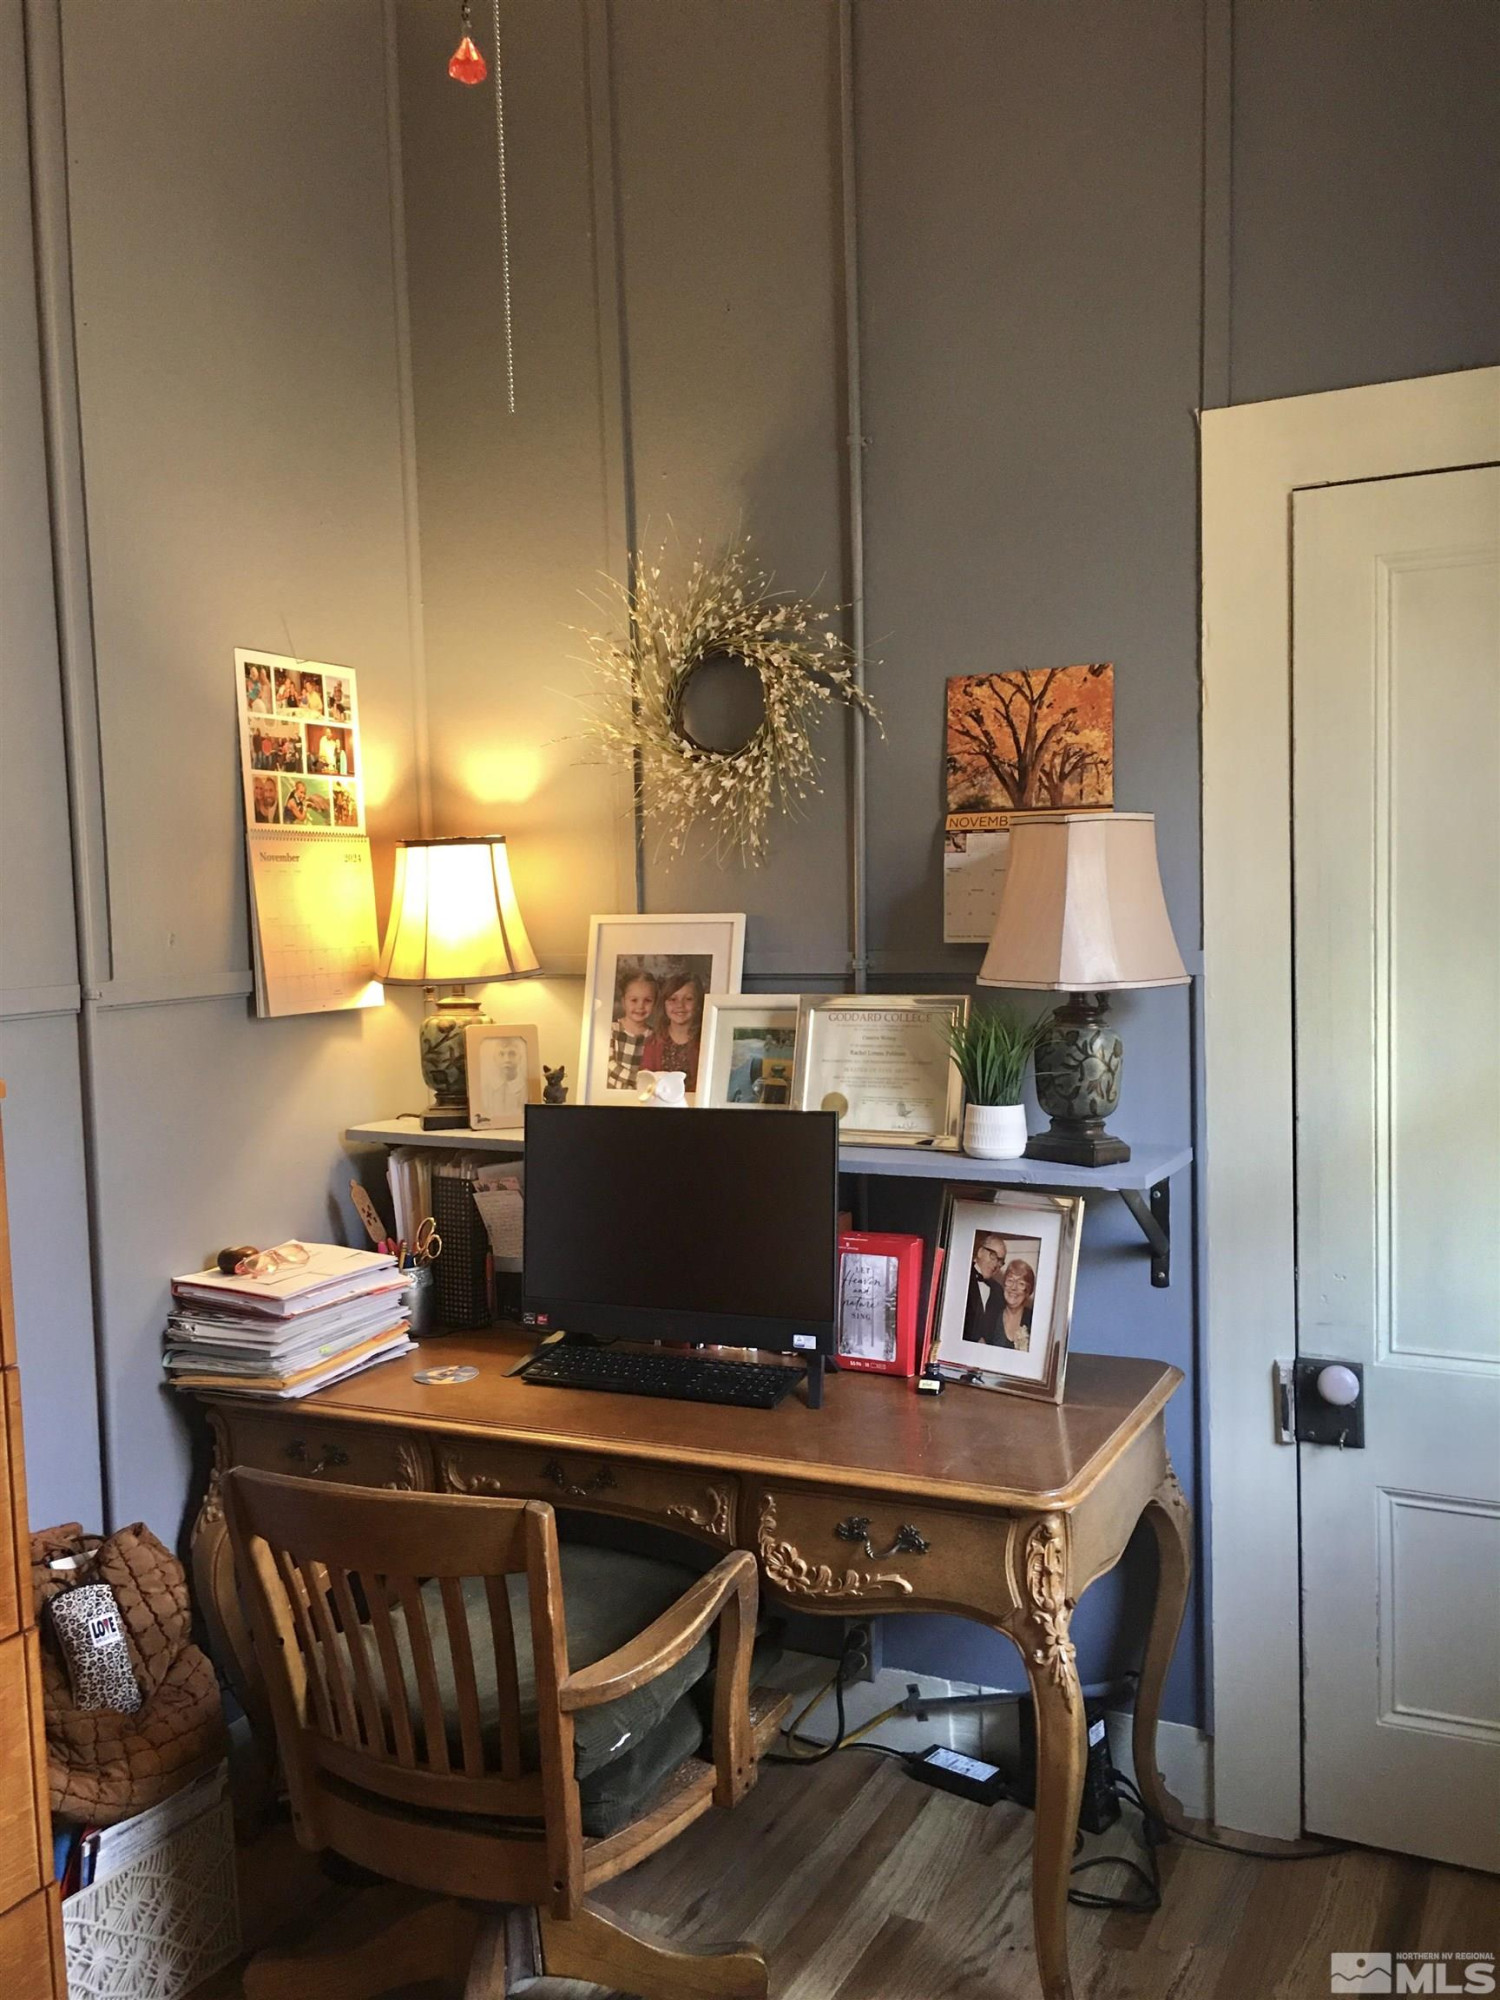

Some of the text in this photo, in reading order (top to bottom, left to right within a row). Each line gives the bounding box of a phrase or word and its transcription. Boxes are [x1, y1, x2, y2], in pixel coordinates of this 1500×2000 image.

[949, 816, 1008, 828] NOVEMB
[260, 852, 300, 862] November
[828, 1012, 932, 1022] GODDARD COLLEGE
[855, 1266, 871, 1274] LET
[851, 1312, 871, 1321] SING
[91, 1616, 117, 1639] LOVE
